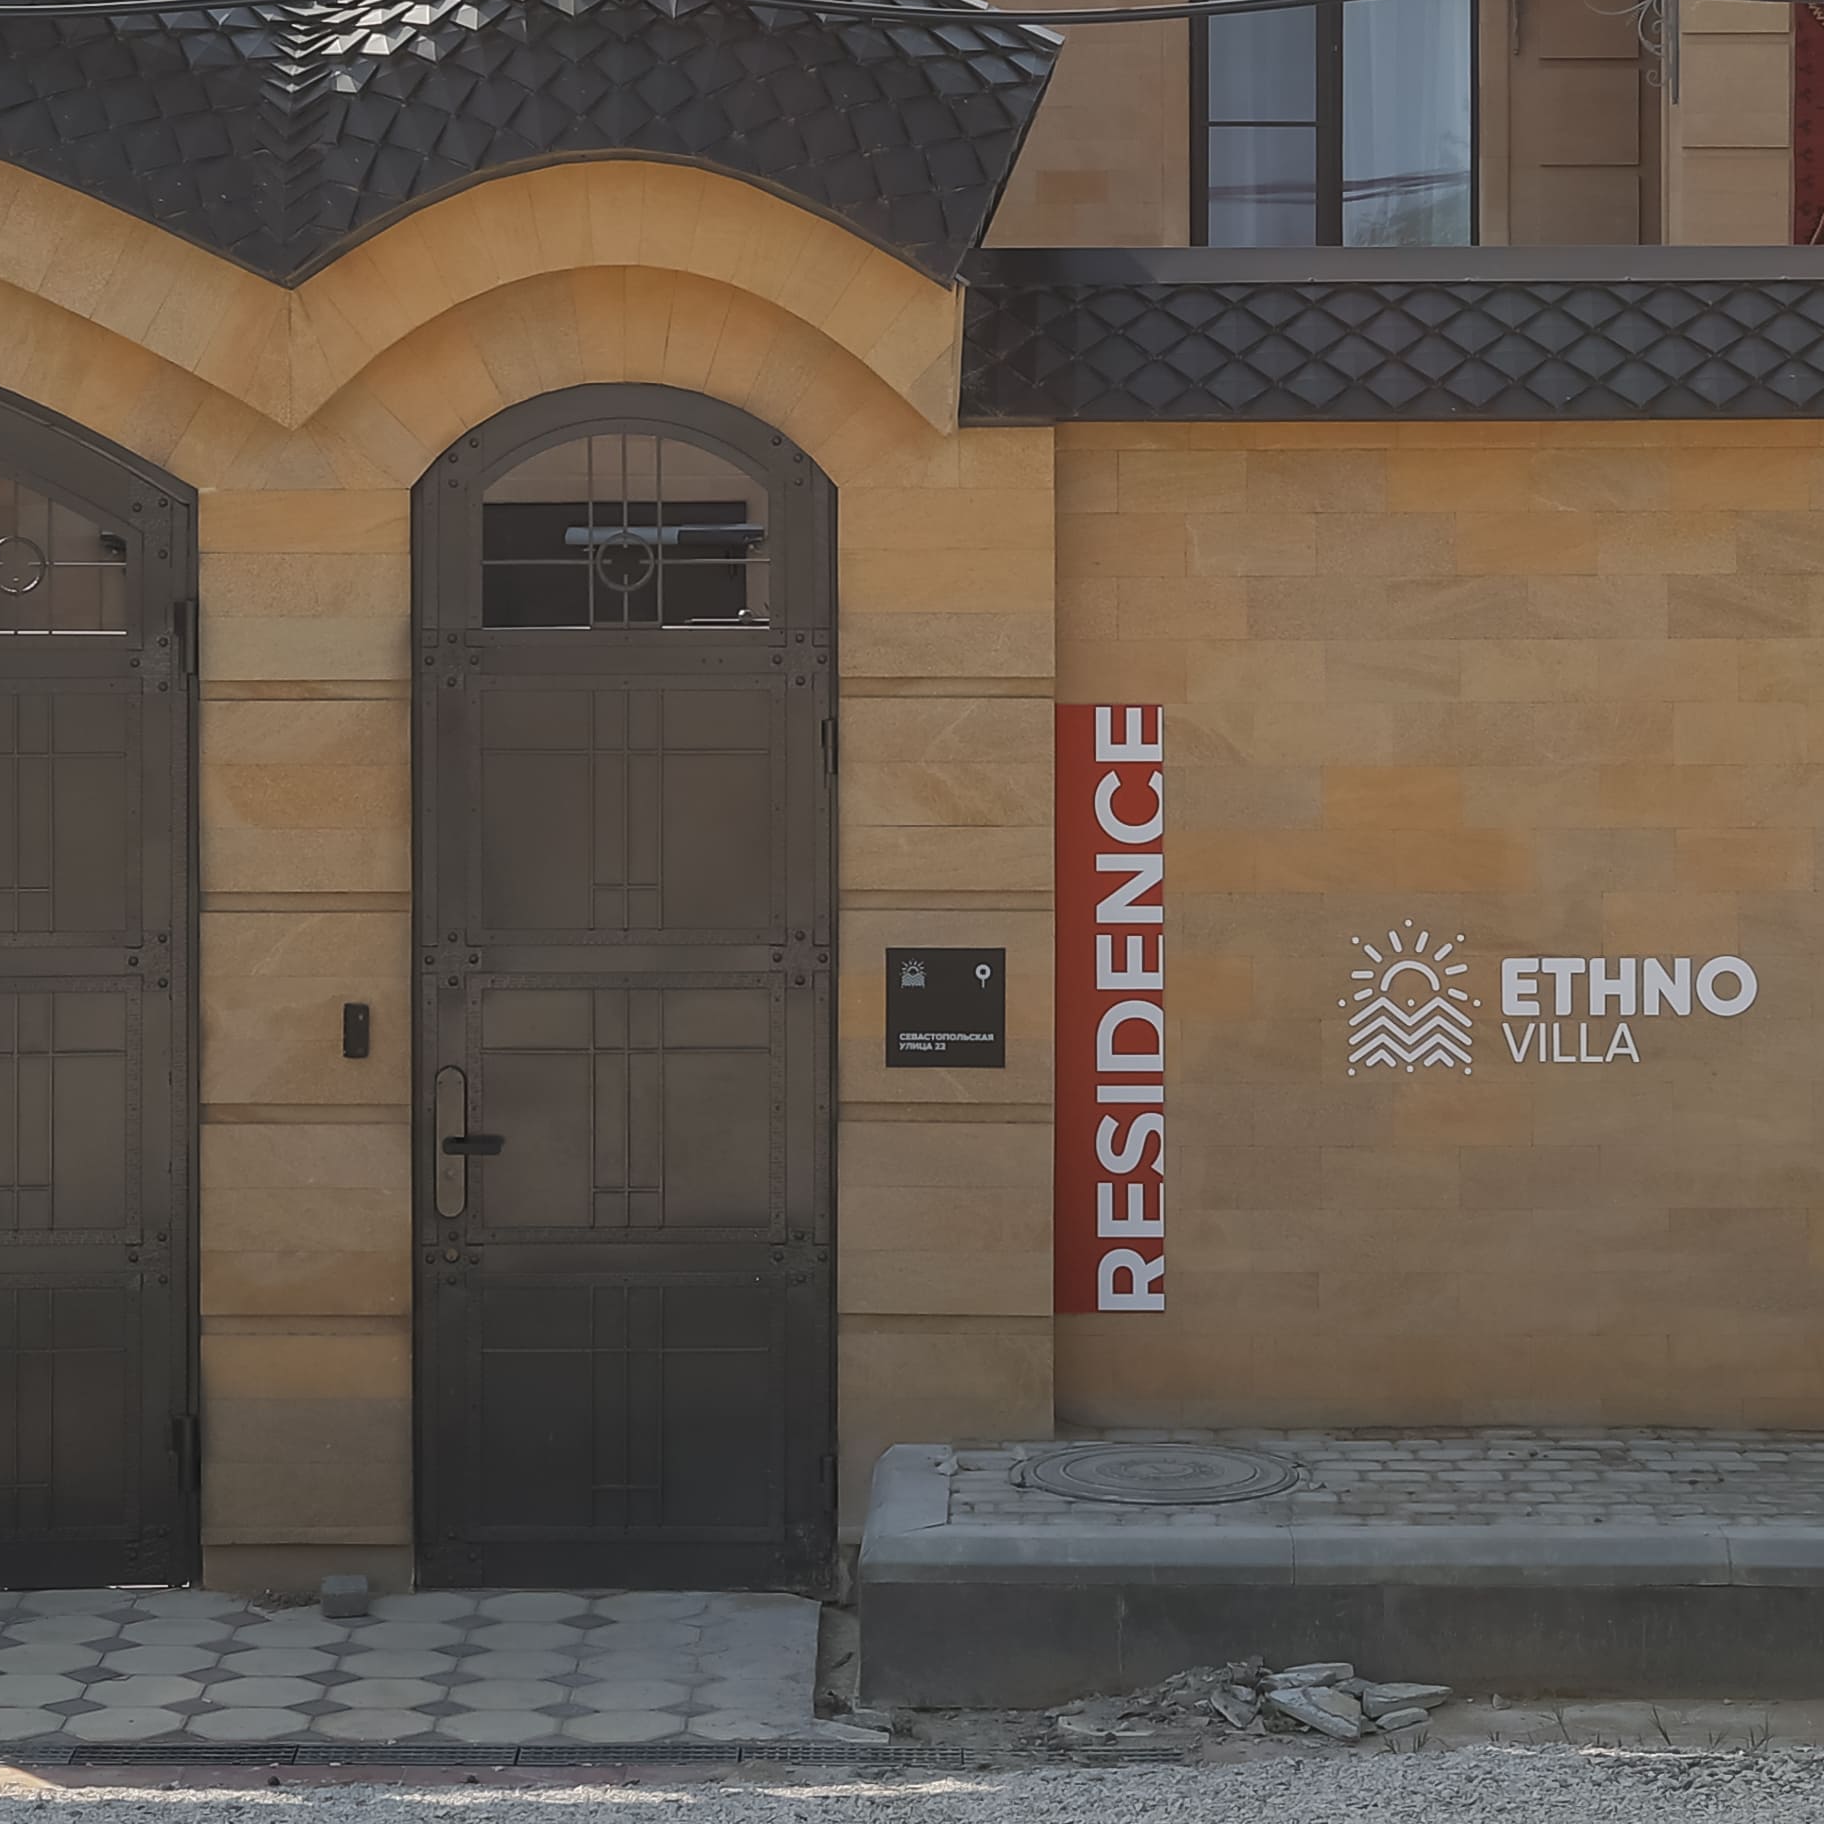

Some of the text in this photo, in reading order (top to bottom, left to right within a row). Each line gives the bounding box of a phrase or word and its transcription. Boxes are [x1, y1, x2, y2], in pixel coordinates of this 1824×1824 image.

[1501, 956, 1758, 1017] ETHNO
[1095, 707, 1165, 1311] RESIDENCE
[899, 1033, 994, 1041] СЕВАСТОПОЛЬСКАЯ
[899, 1042, 933, 1051] УЛИЦА
[1502, 1022, 1640, 1063] VILLA
